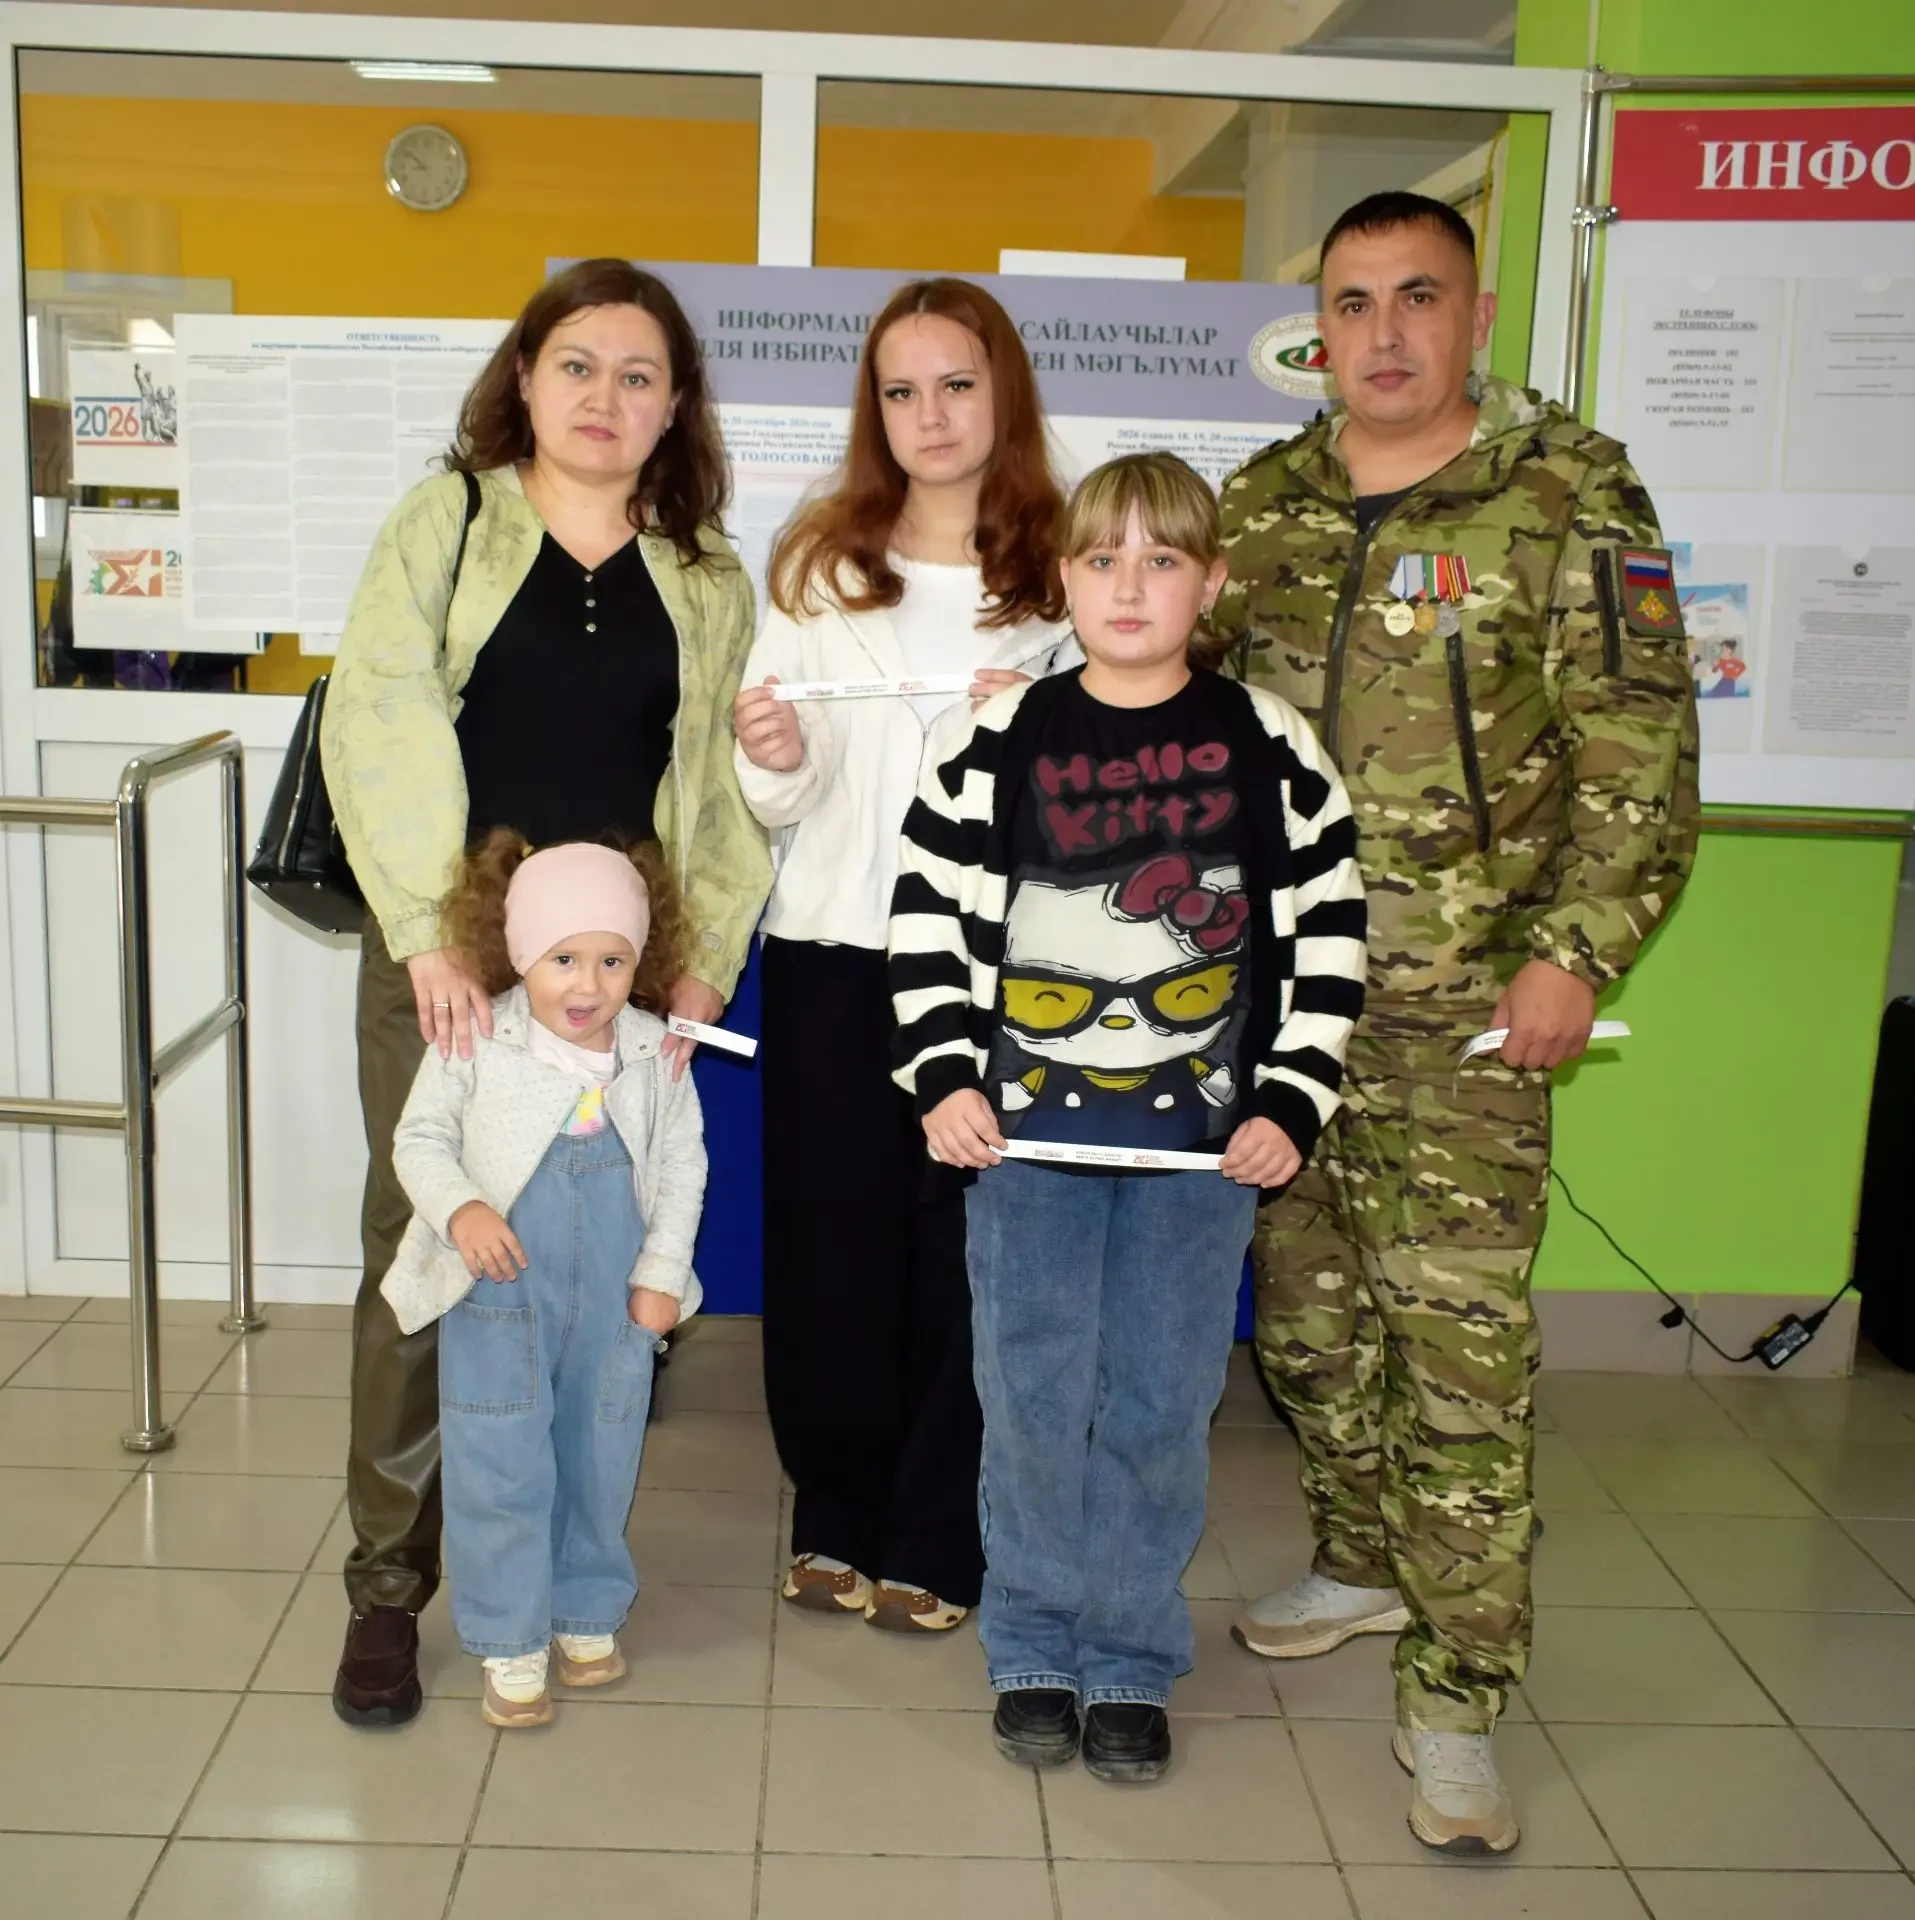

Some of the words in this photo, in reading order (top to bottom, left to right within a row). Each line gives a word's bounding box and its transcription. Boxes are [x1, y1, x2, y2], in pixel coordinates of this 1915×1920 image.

[1695, 139, 1915, 190] ИНФО
[751, 340, 860, 364] ИЗБИРАТ
[1018, 317, 1219, 346] САЙЛАУЧЫЛАР
[74, 405, 140, 437] 2026
[1035, 741, 1230, 797] Hello
[1045, 791, 1234, 854] Kitty
